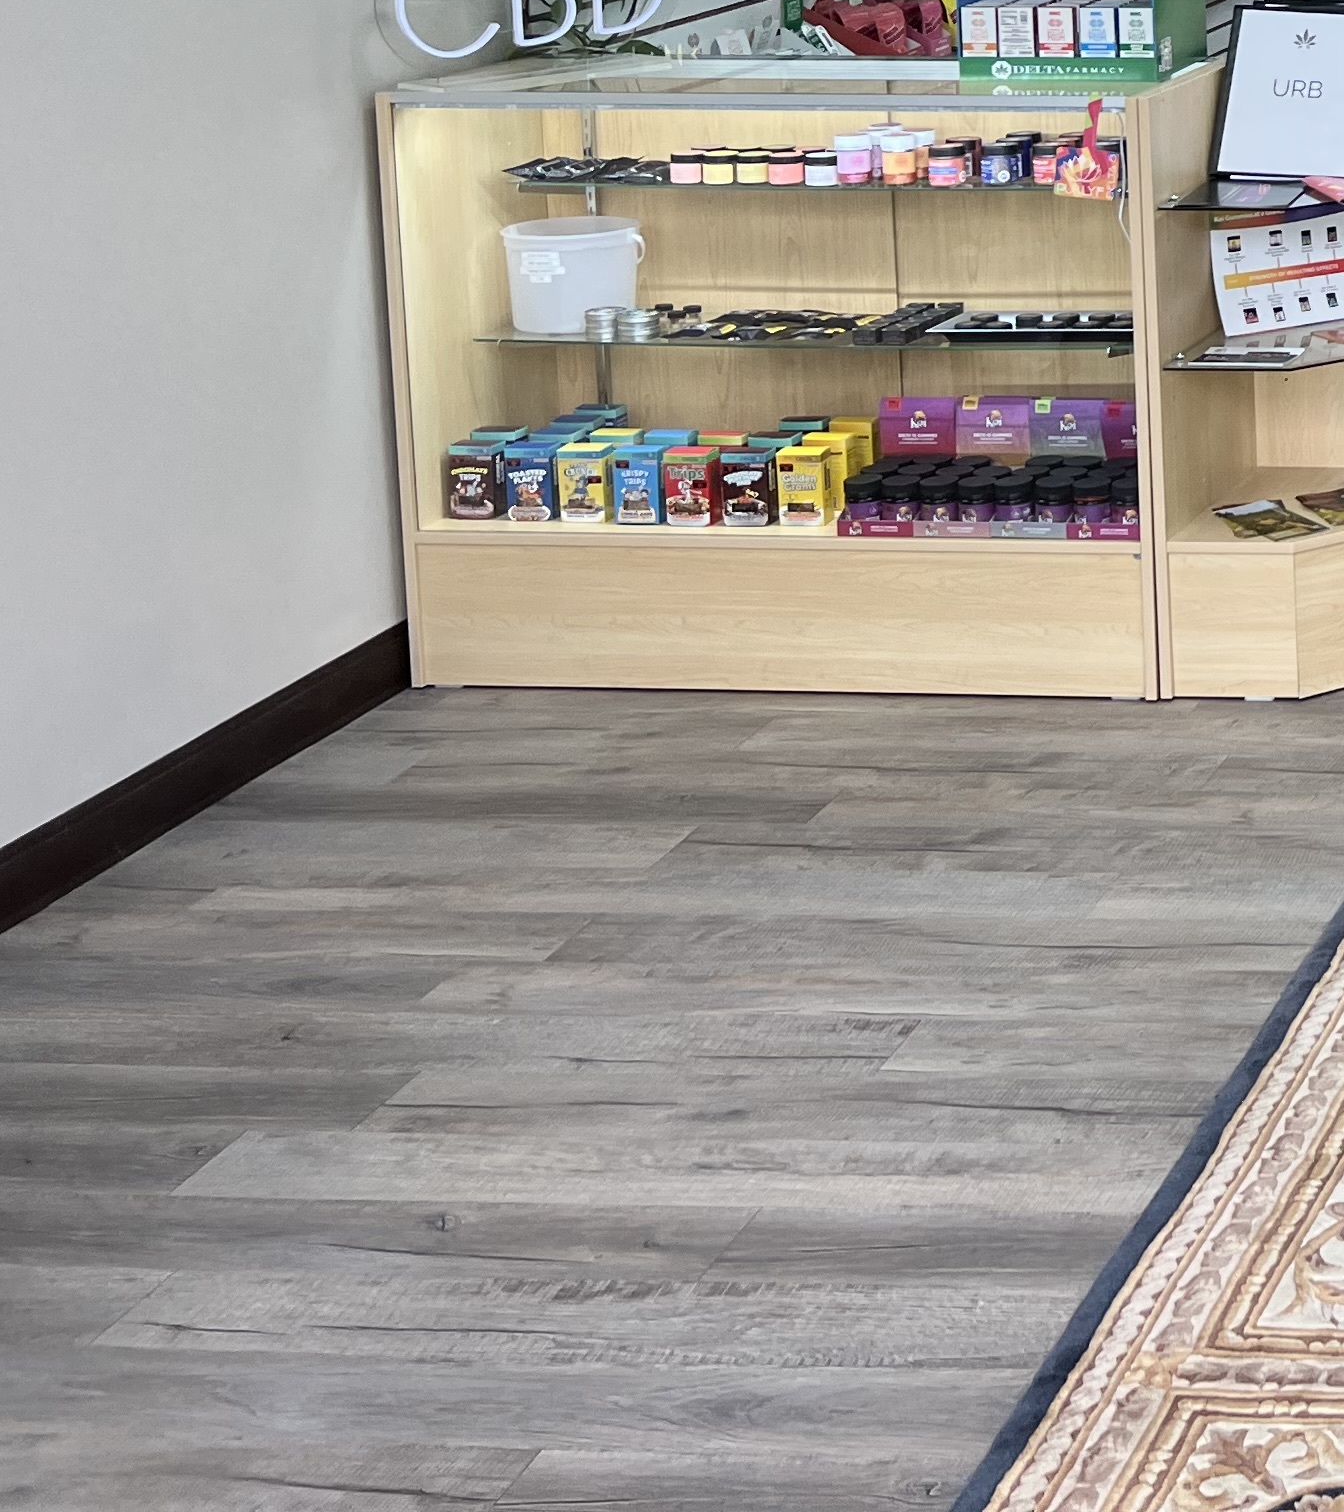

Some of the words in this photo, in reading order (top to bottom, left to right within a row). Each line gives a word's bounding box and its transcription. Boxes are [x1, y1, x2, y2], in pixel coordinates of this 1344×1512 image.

[1013, 64, 1065, 74] DELTA
[1273, 79, 1324, 99] URB
[508, 469, 547, 478] TOASTED
[667, 465, 706, 481] Trips
[782, 474, 817, 484] Golden
